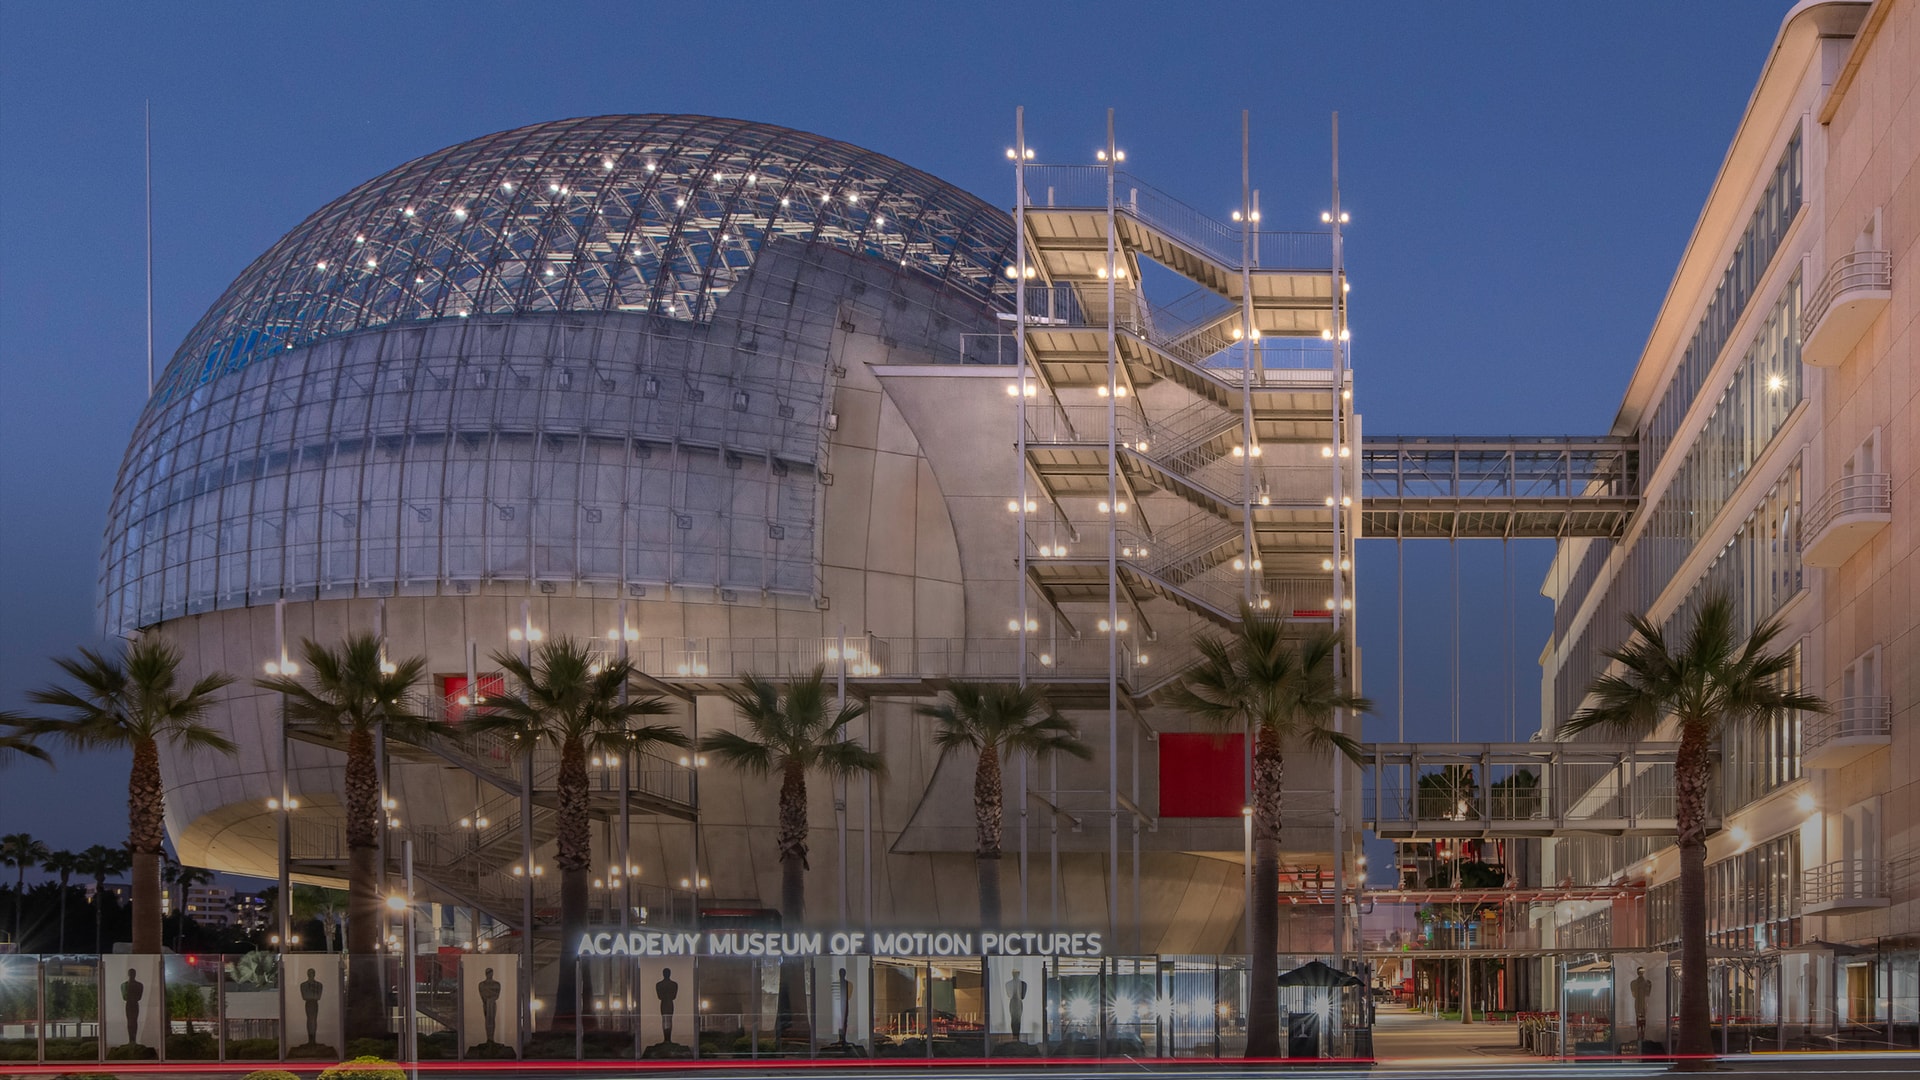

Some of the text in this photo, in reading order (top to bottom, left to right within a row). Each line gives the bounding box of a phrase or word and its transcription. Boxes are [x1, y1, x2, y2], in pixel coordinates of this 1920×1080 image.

[578, 933, 1101, 955] ACADEMY MUSEUM OF MOTION PICTURES
